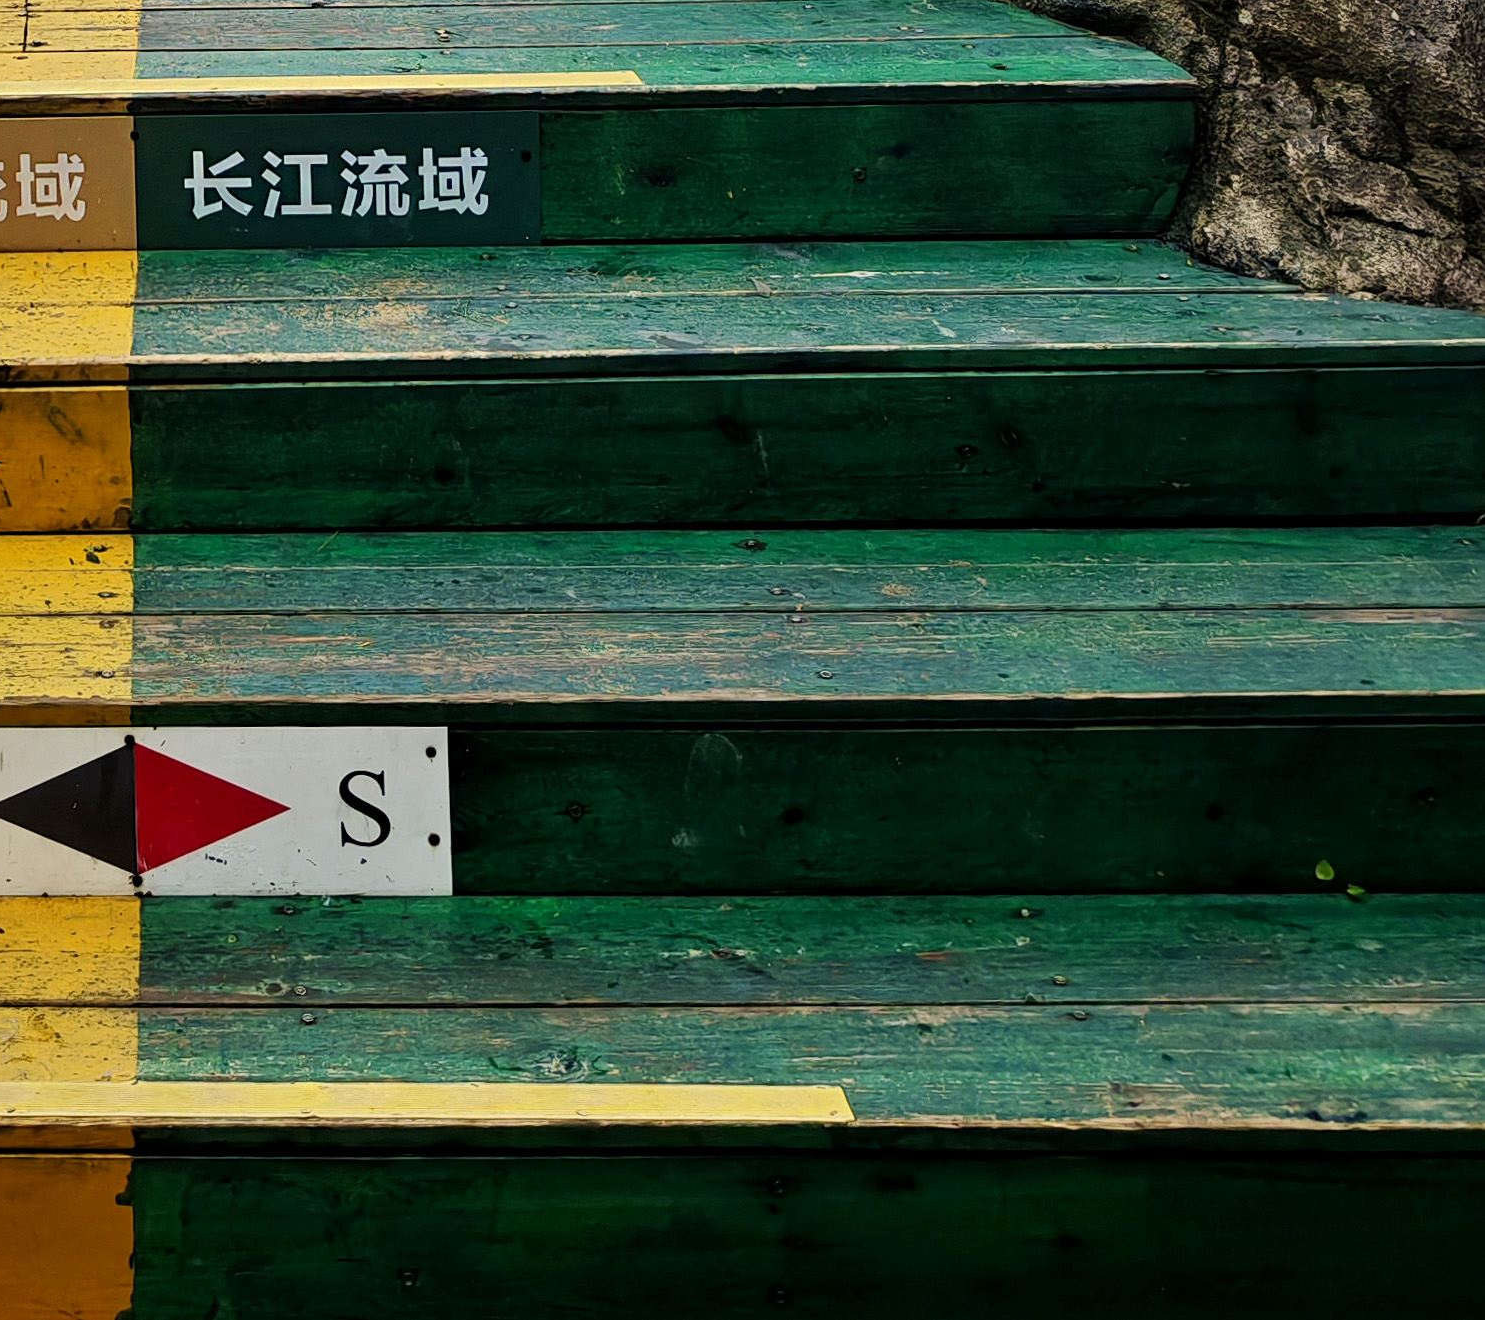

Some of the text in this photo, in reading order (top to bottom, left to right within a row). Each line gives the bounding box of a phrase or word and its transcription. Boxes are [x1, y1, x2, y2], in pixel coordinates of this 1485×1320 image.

[183, 146, 490, 220] 长江流域
[338, 769, 392, 848] S
